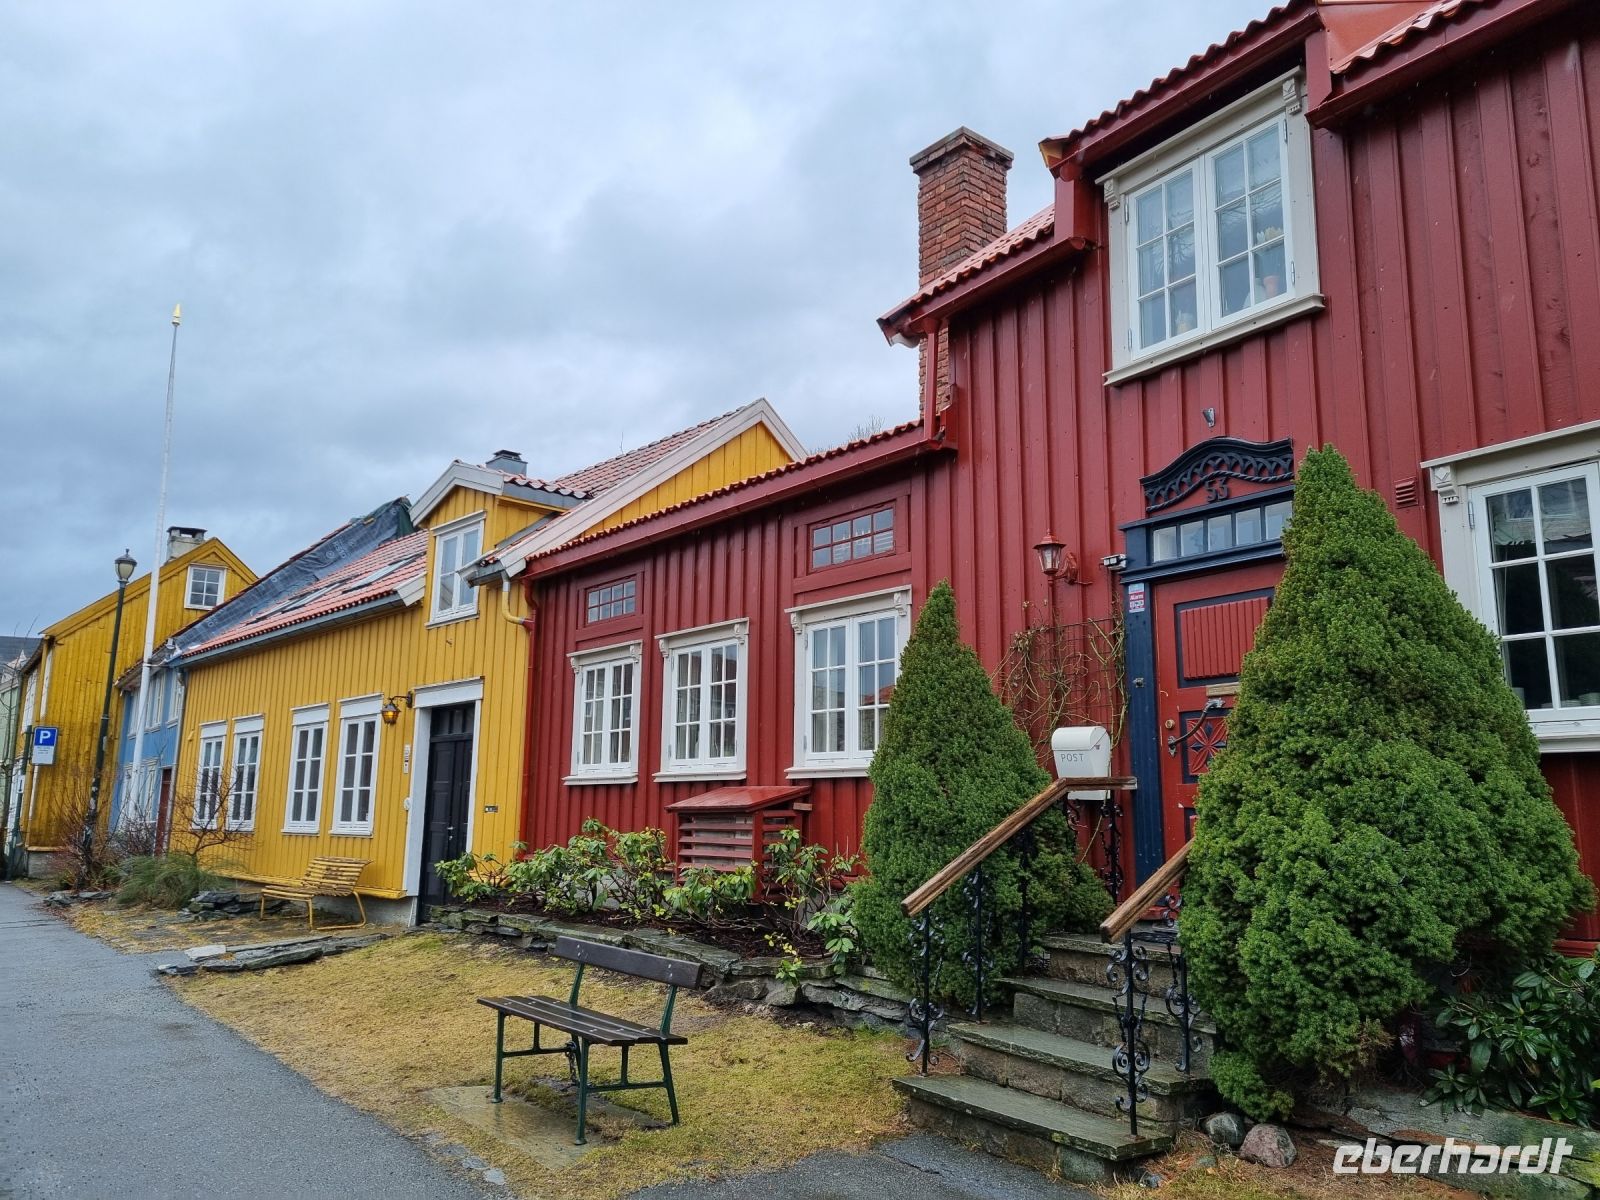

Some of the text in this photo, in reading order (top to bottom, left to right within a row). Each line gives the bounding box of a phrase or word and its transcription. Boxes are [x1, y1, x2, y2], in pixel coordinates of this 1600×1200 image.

[1205, 478, 1228, 502] 53
[39, 730, 51, 744] P
[1060, 753, 1083, 762] POST
